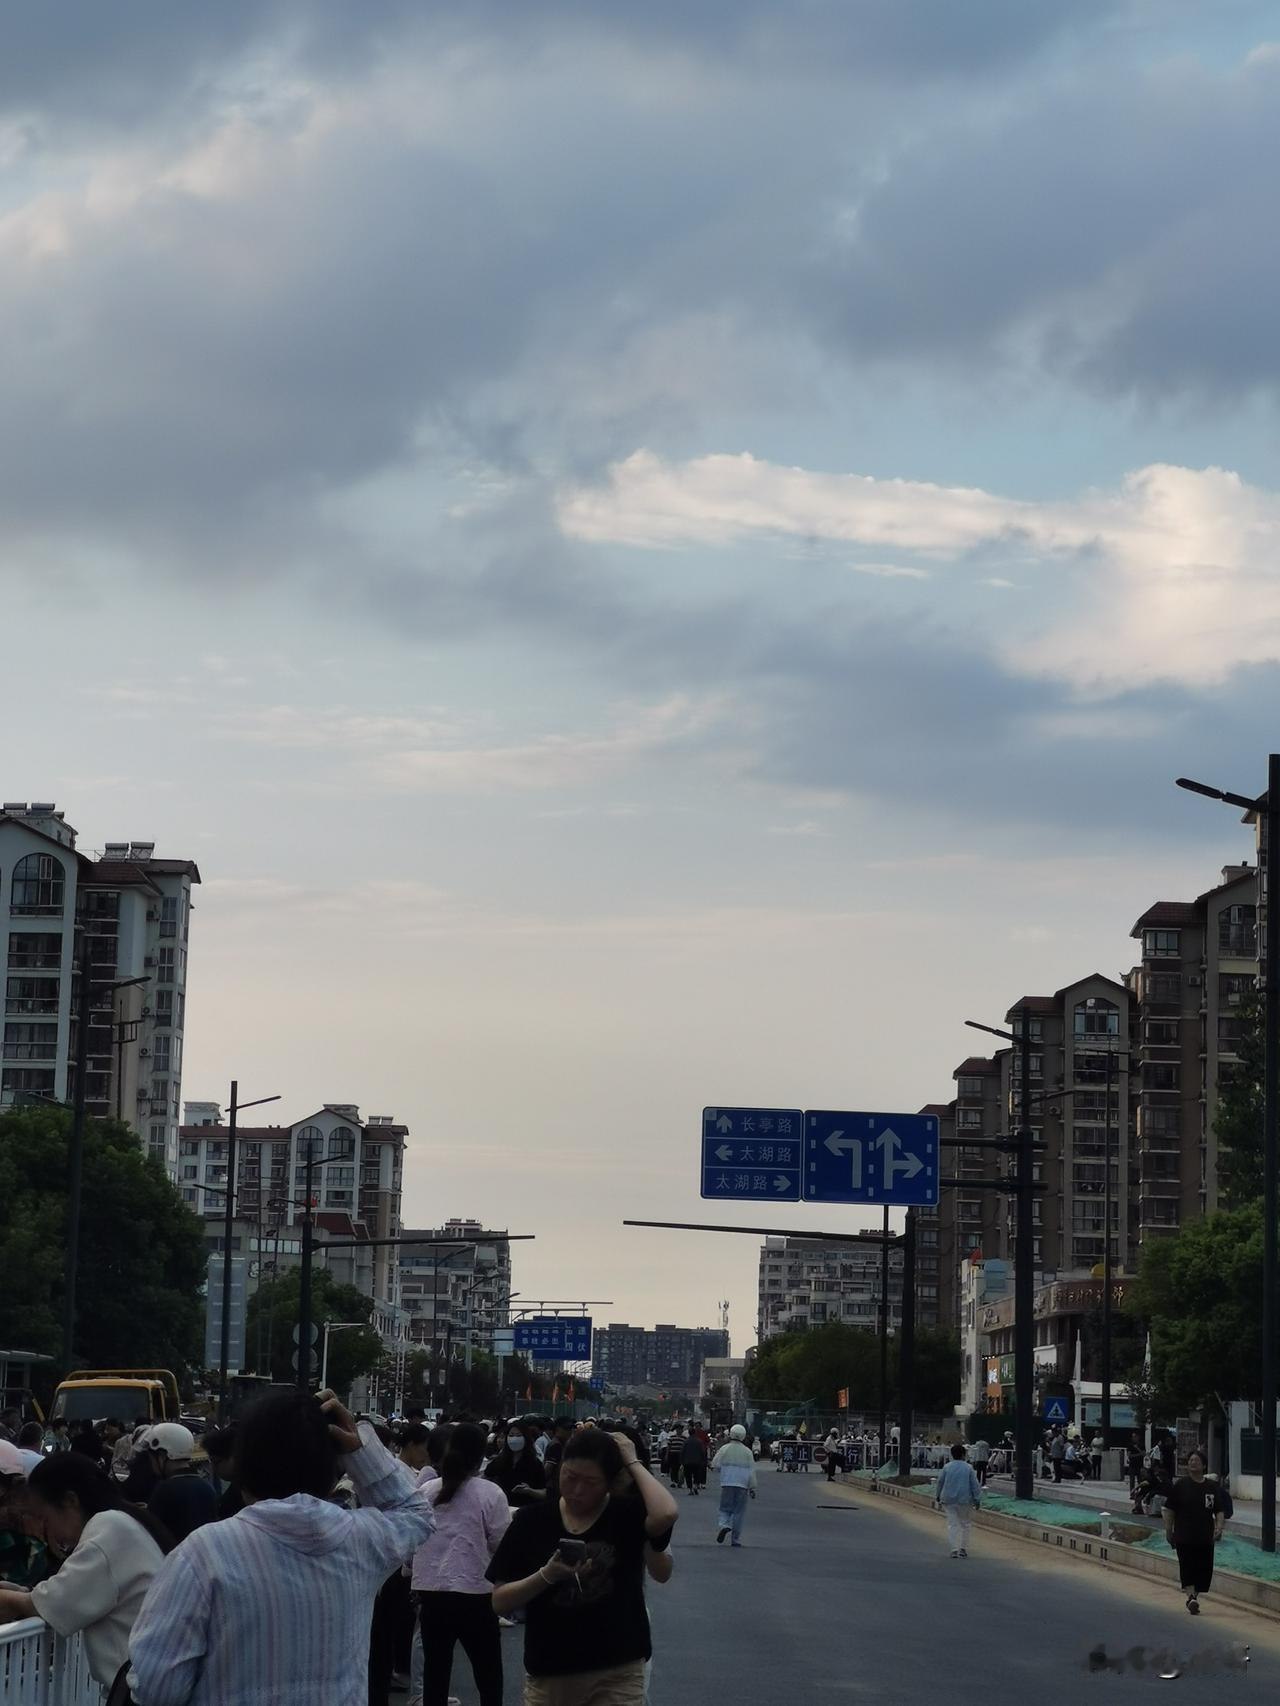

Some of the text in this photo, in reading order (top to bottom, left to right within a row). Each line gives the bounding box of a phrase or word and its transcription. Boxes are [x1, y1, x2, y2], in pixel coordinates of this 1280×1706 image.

[740, 1116, 793, 1135] 长亭路
[739, 1144, 792, 1163] 太湖路
[715, 1173, 769, 1192] 太湖路
[783, 1446, 809, 1462] 禁止
